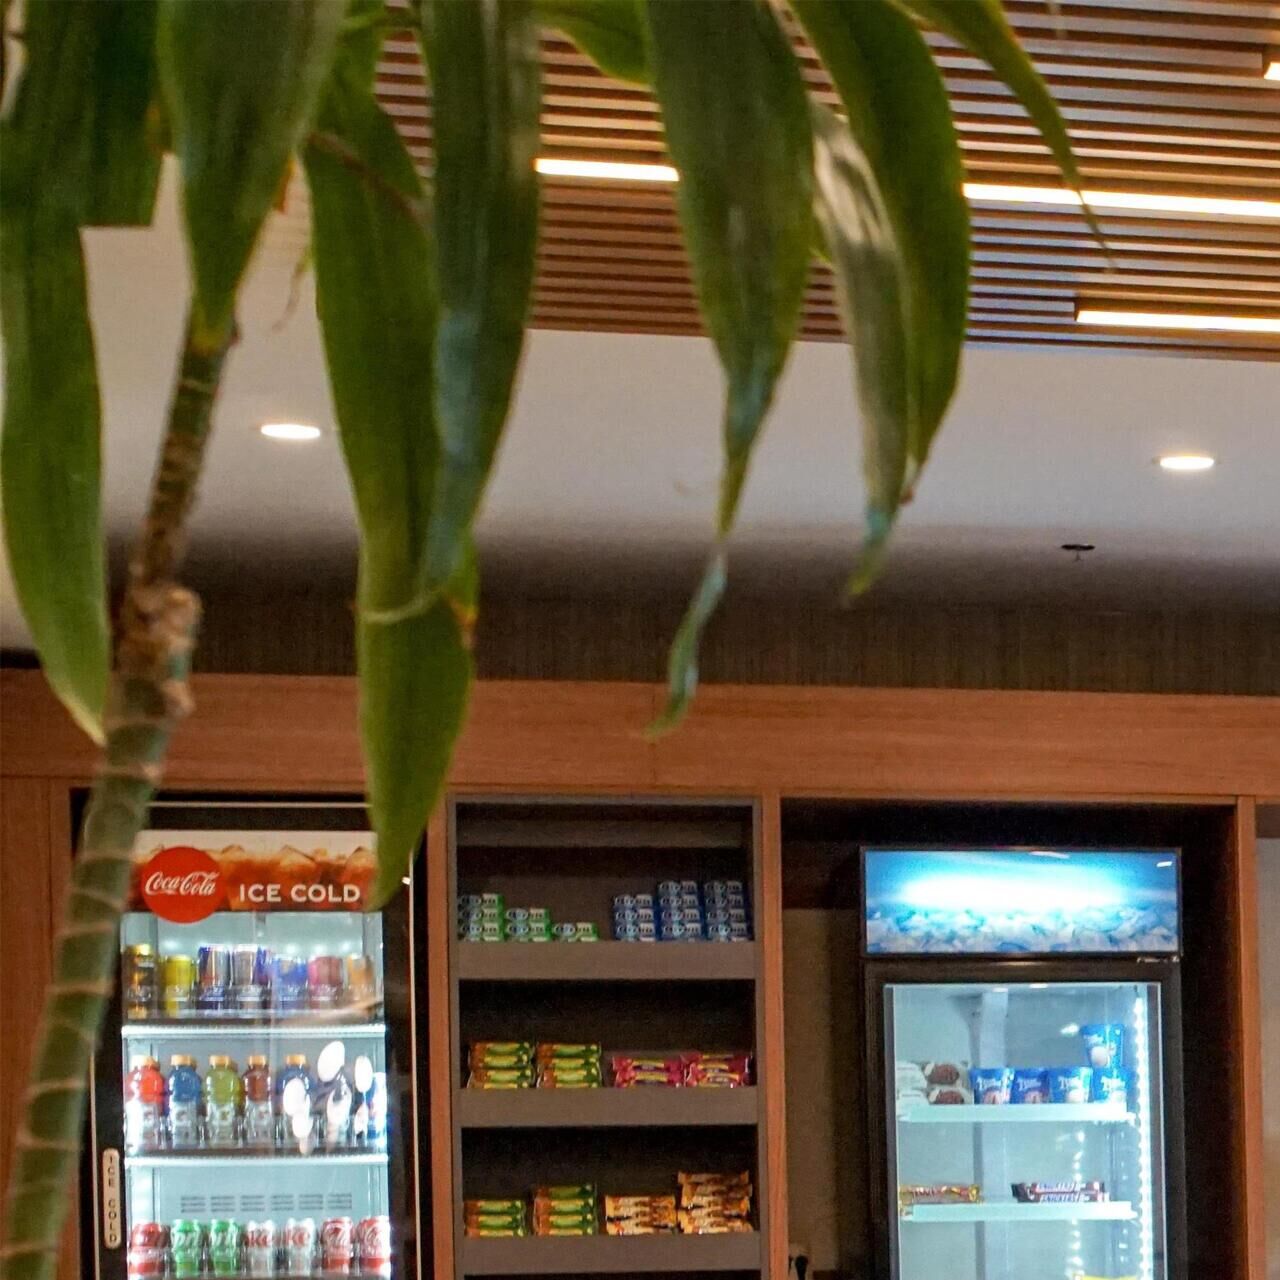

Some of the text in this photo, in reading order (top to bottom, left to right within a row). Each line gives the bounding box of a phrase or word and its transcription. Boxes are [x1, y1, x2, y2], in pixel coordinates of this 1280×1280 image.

[144, 871, 220, 896] Coca-Cola
[239, 884, 361, 903] ICE COLD
